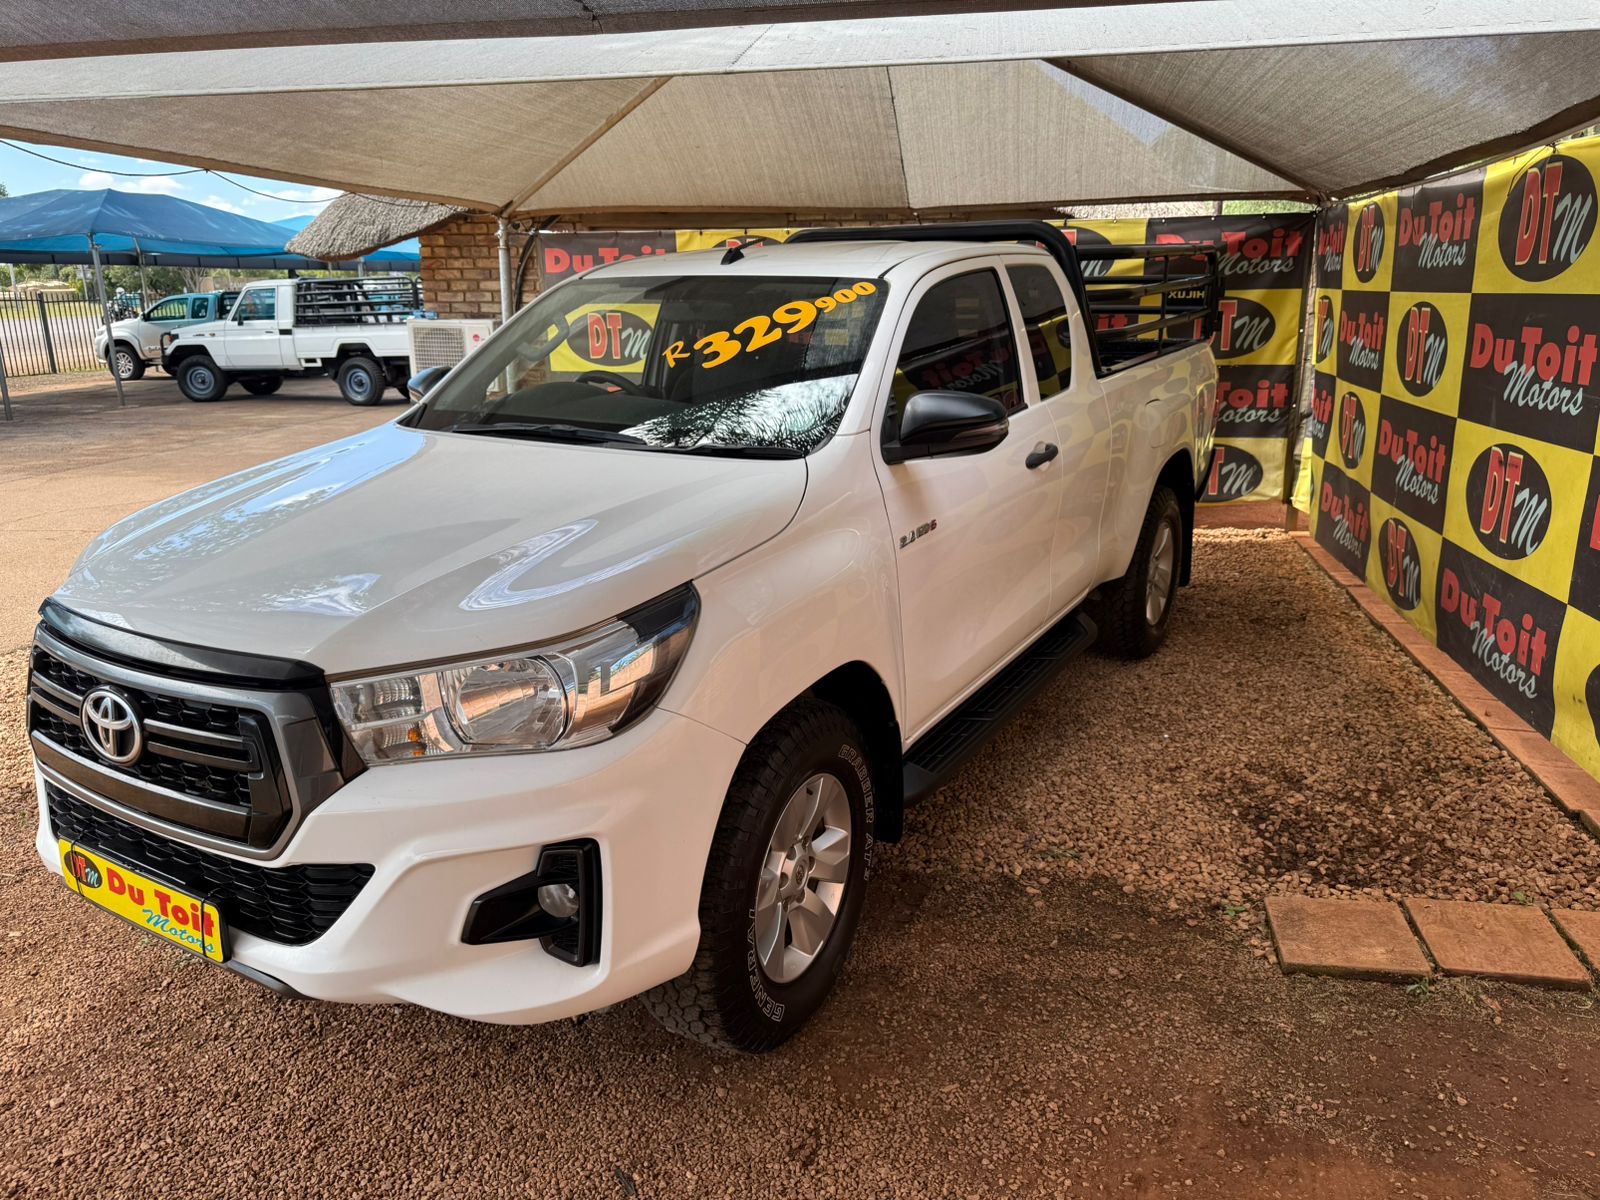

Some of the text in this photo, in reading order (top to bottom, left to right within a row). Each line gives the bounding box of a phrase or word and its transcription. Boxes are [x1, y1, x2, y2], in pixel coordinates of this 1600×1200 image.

[1418, 232, 1468, 269] Motors
[662, 341, 691, 368] R
[1504, 360, 1583, 416] Motors
[1396, 454, 1439, 505] Motors
[1470, 621, 1538, 699] Motors
[106, 867, 215, 937] Du Toit
[142, 908, 215, 953] Motors
